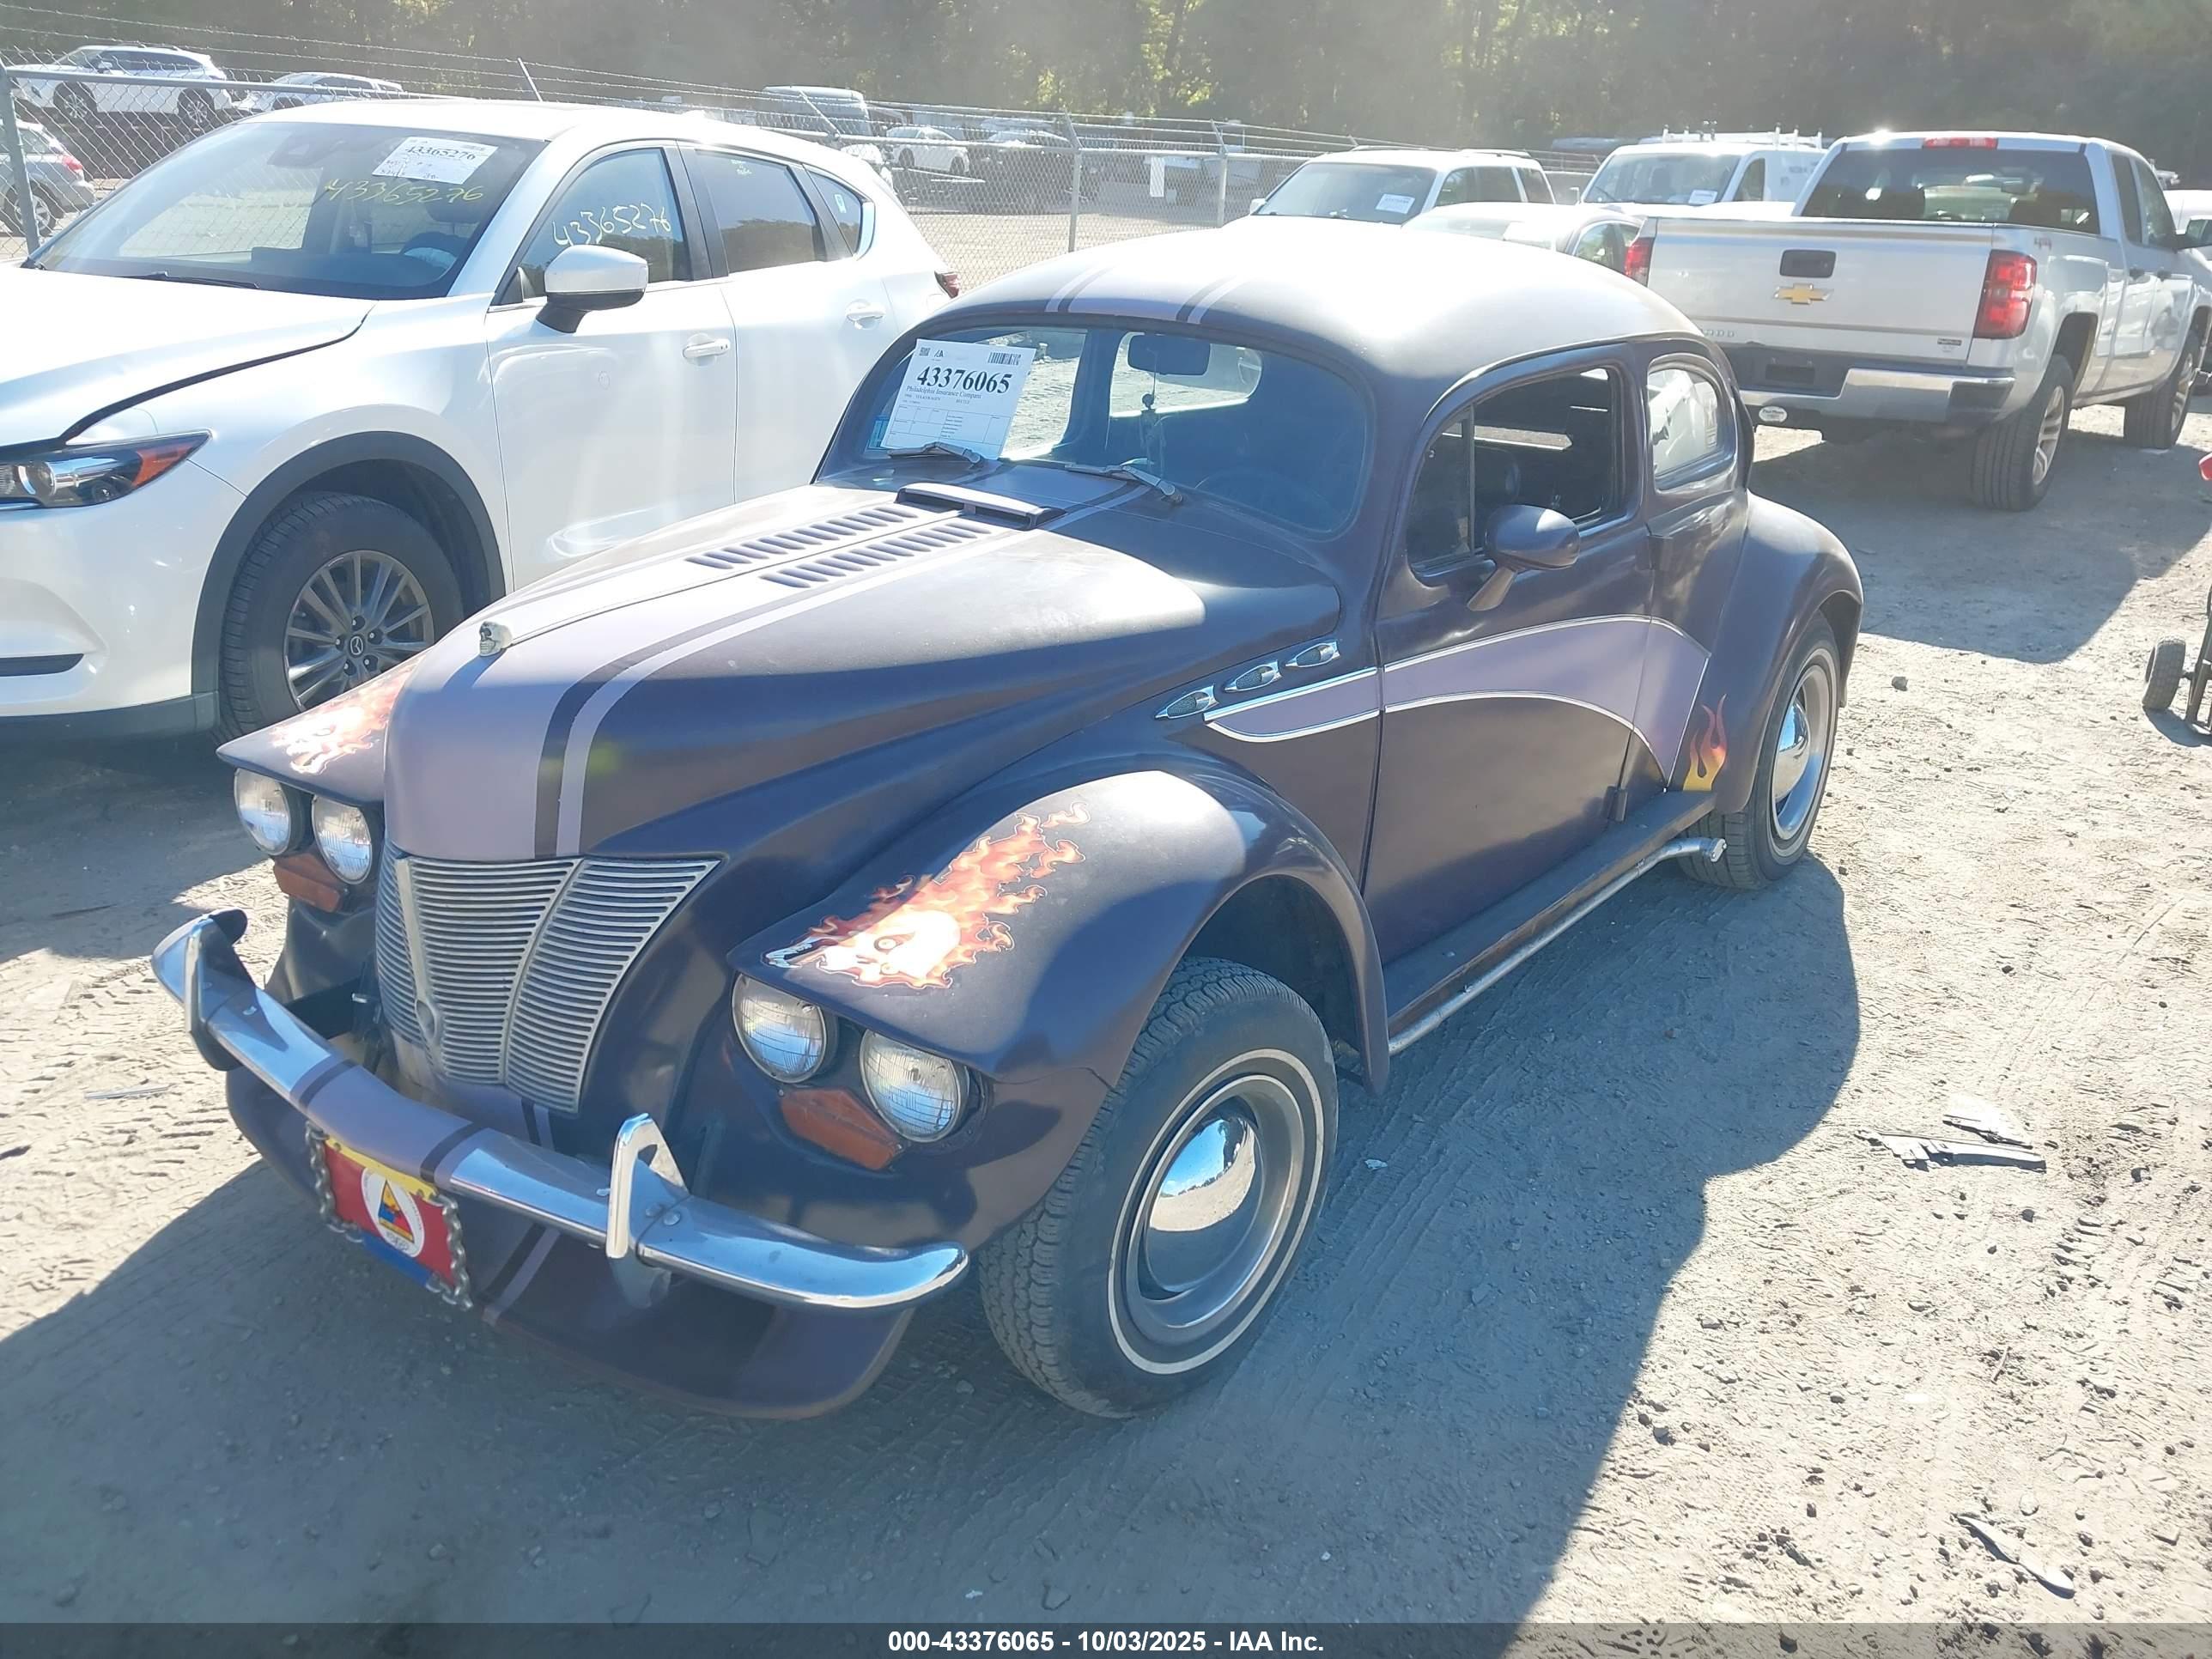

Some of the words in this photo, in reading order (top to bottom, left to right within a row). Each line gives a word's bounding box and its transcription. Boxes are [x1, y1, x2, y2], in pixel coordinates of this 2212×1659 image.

[325, 179, 484, 205] 43365276
[552, 202, 672, 246] 43365276
[917, 366, 1012, 393] 43376065
